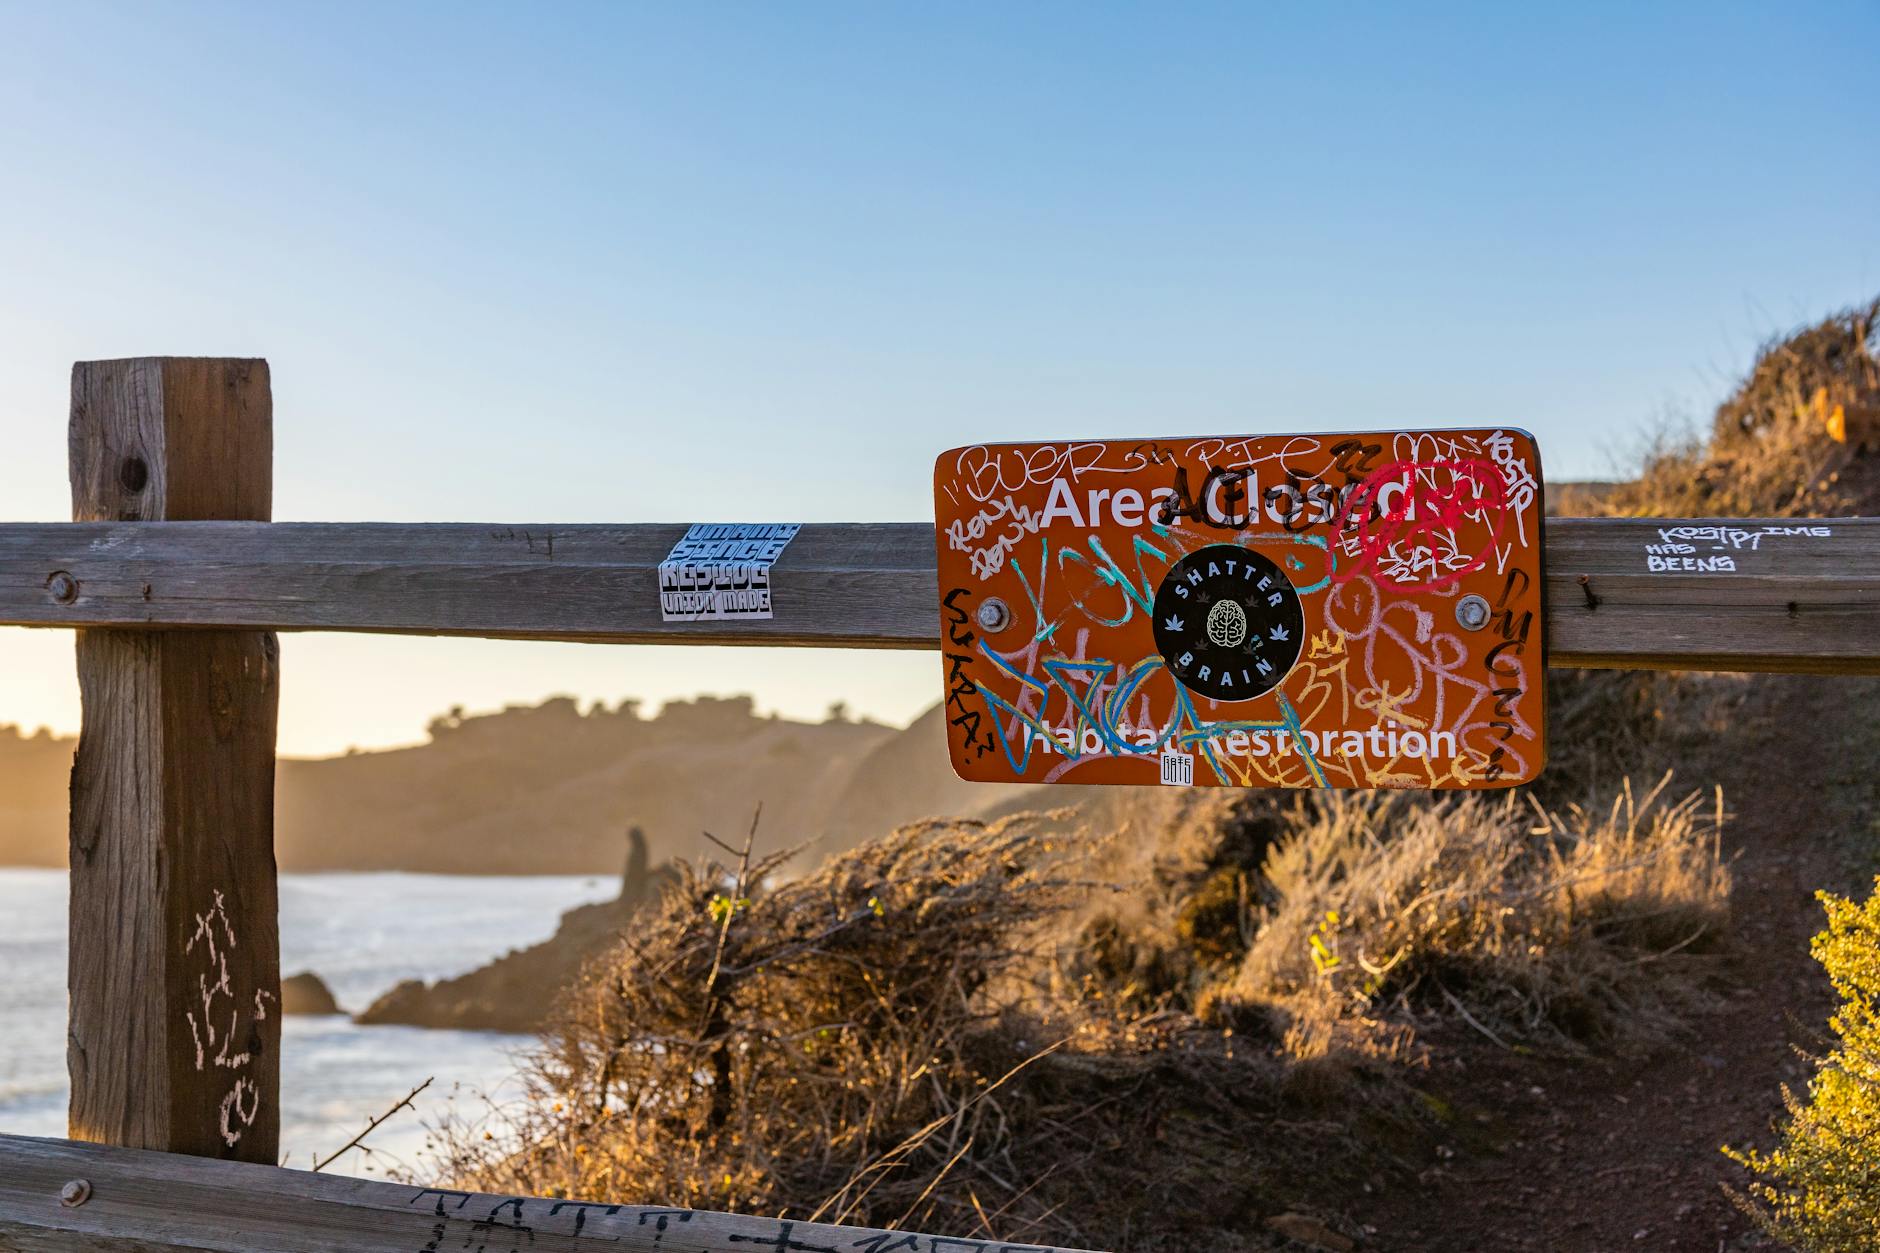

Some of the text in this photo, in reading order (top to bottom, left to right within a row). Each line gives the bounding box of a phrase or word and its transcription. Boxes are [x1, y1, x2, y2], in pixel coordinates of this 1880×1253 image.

[1039, 476, 1182, 529] Area
[1647, 555, 1736, 572] BEENS
[1175, 560, 1283, 608] SHATTER
[662, 590, 770, 615] UNION MADE
[1178, 651, 1272, 687] BRAIN
[1023, 719, 1177, 755] Habtat
